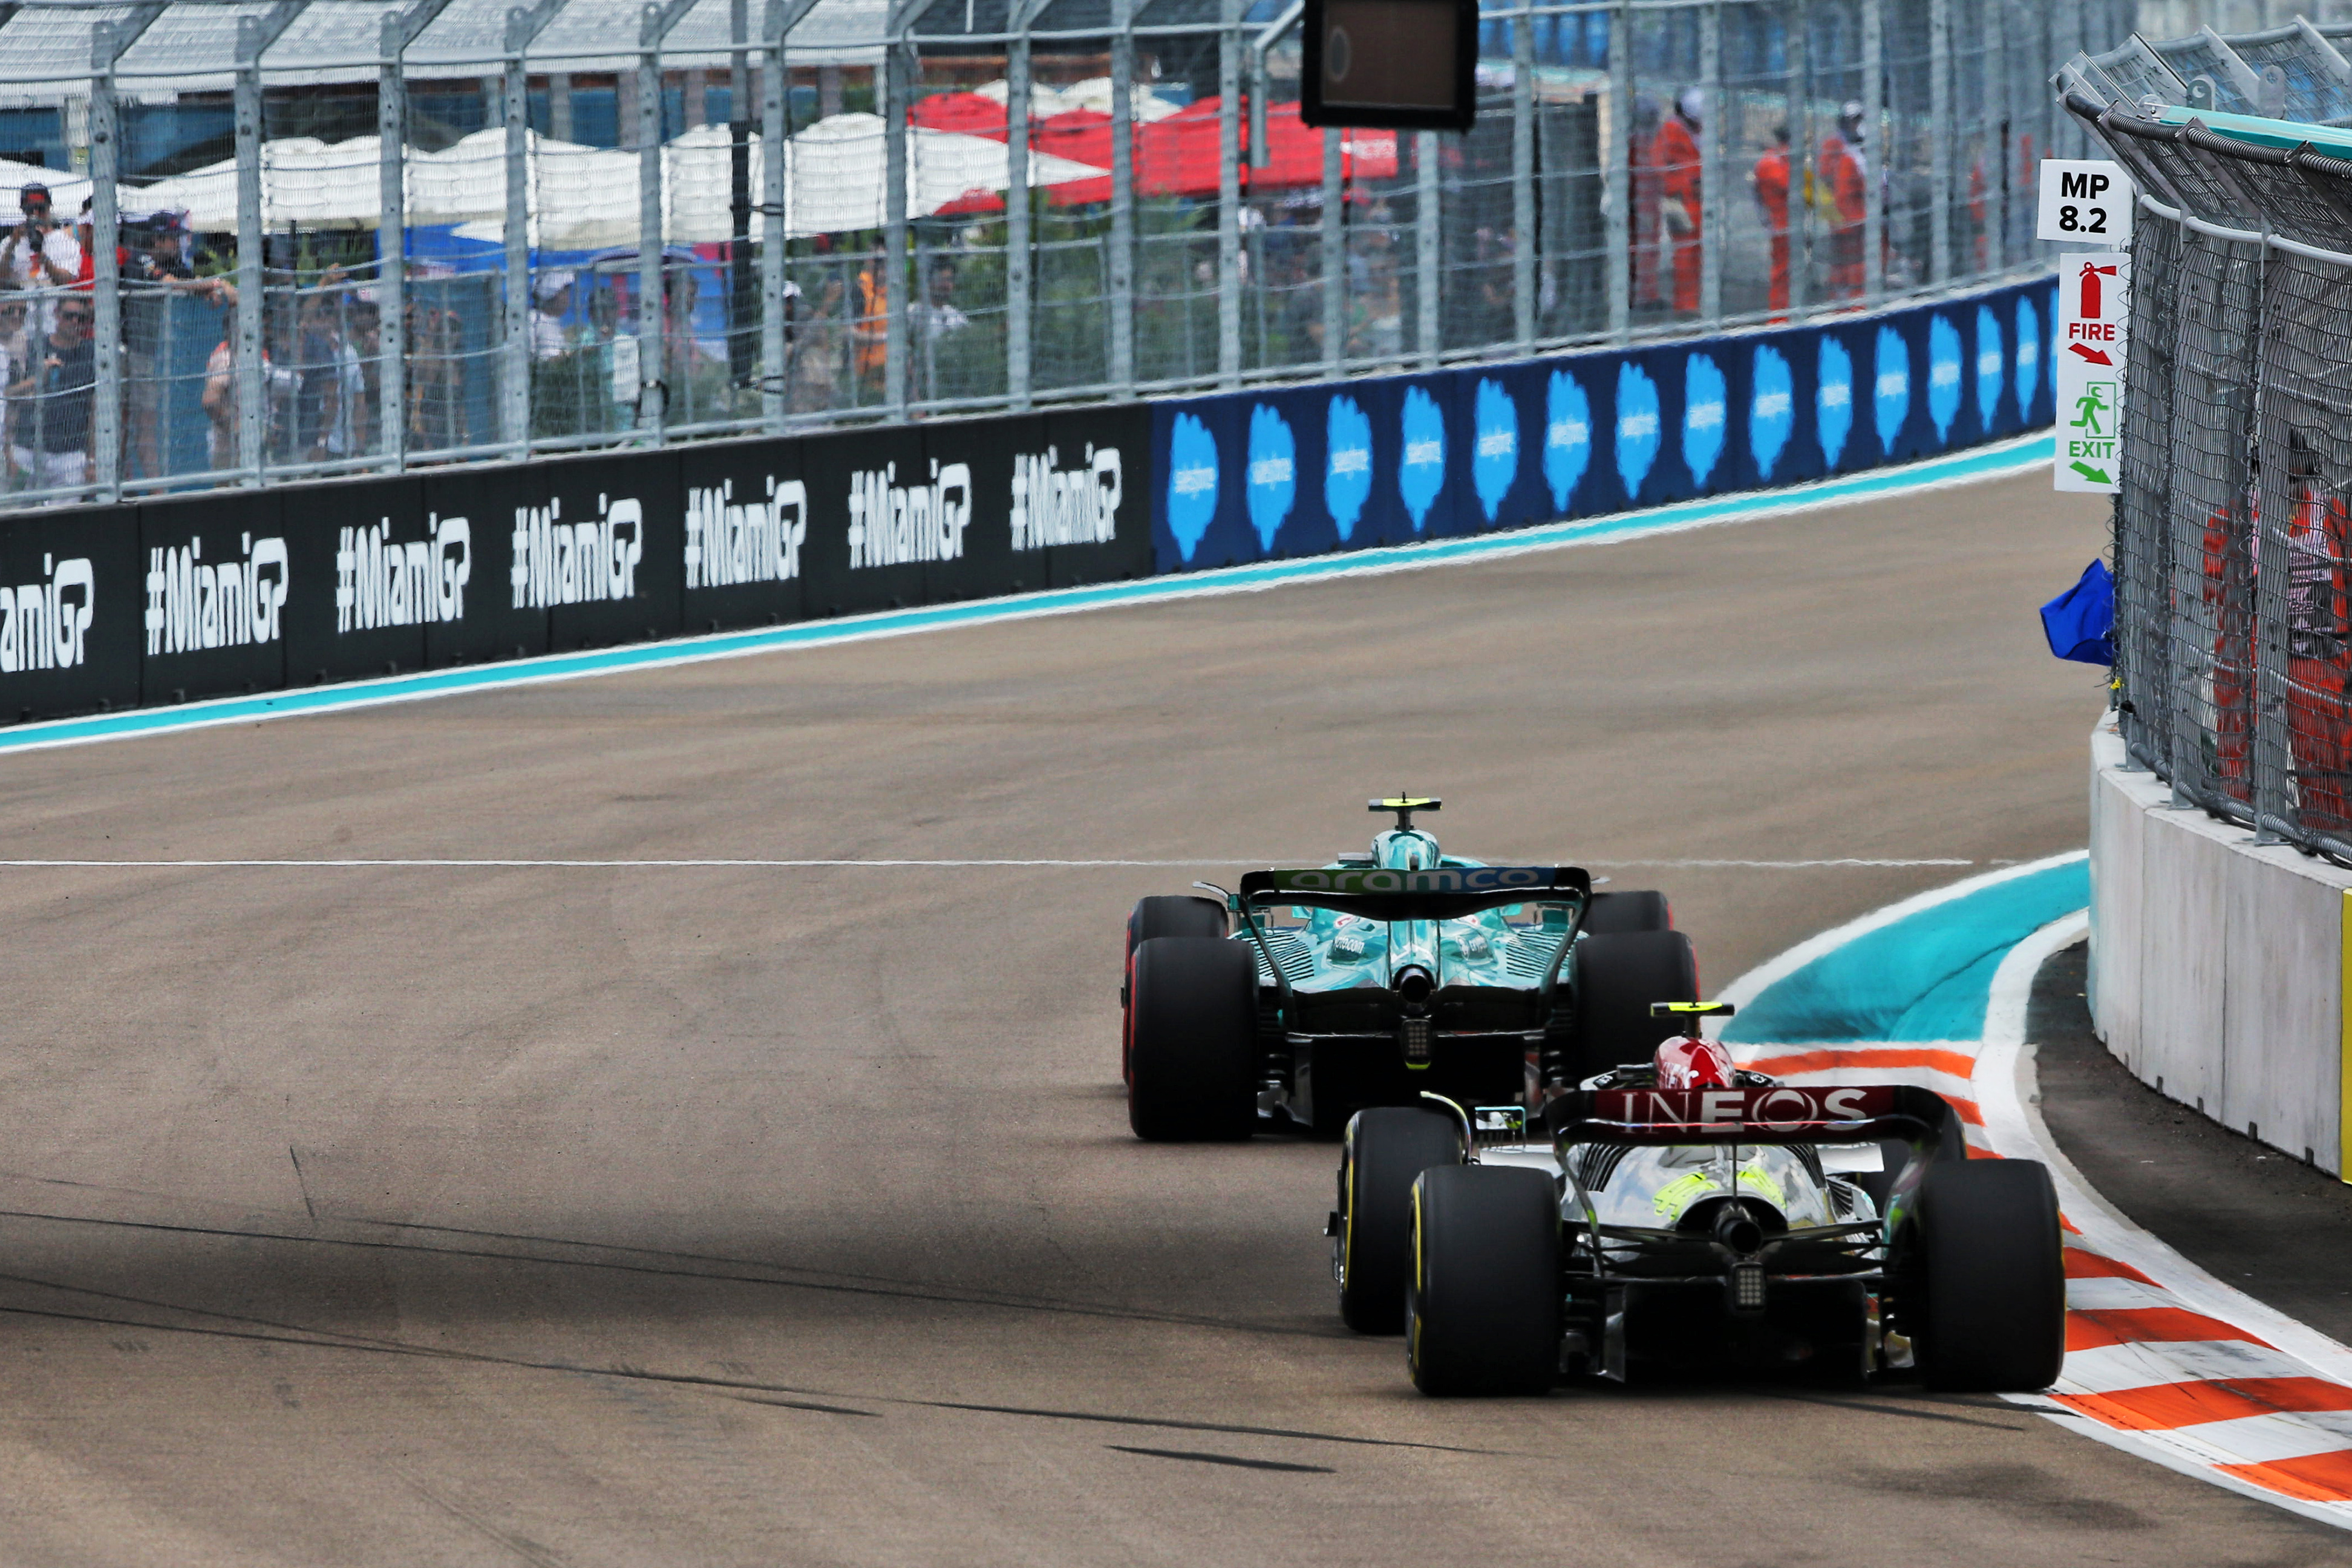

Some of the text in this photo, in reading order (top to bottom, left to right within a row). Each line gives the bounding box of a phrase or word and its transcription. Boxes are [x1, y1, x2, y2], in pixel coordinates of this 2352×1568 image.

[2061, 172, 2109, 200] MP
[2059, 205, 2107, 234] 8.2
[2068, 322, 2115, 341] FIRE
[2069, 440, 2115, 459] EXIT
[684, 475, 807, 589] #MiamiGP
[848, 458, 972, 569] #MiamiGP
[336, 512, 471, 633] #MiamiGP
[511, 492, 642, 609] #MiamiGP
[145, 532, 289, 656] #MiamiGP
[1290, 868, 1539, 892] aramco
[1622, 1088, 1868, 1134] INEOS
